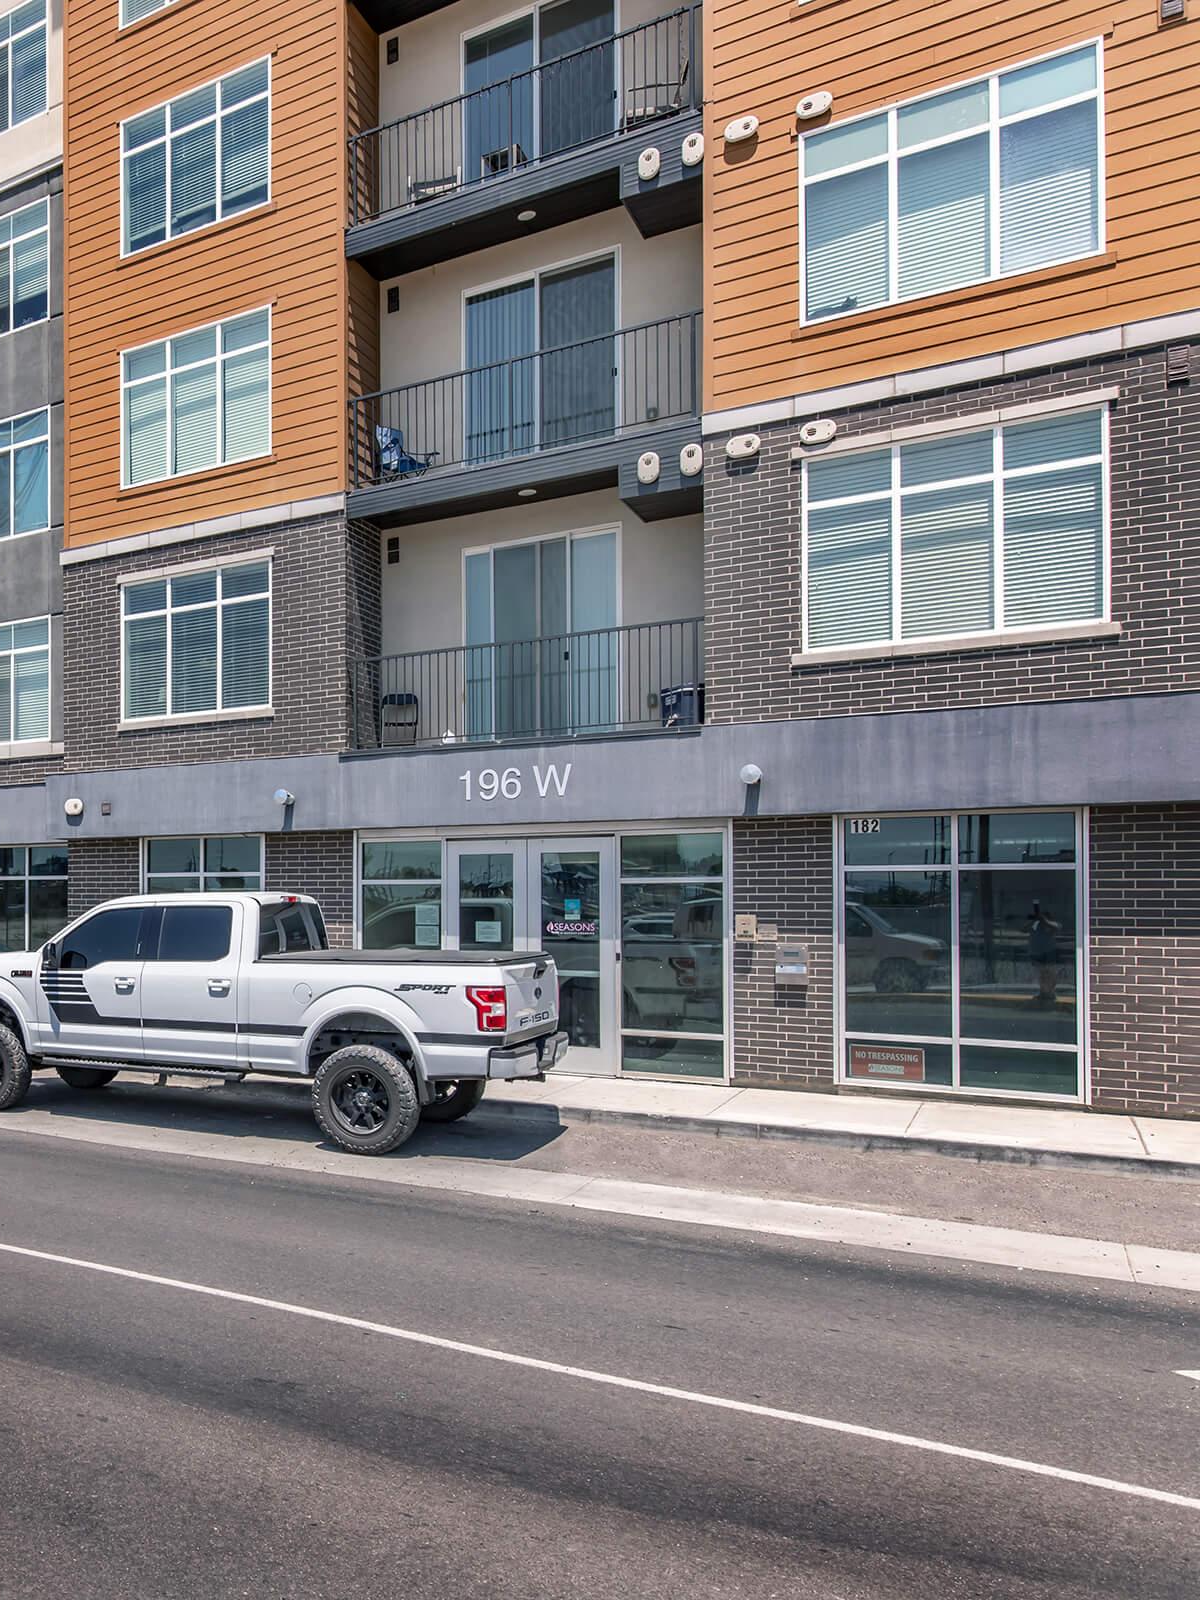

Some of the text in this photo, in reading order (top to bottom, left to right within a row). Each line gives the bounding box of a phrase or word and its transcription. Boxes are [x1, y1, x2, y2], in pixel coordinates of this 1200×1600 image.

[459, 763, 572, 801] 196 W
[851, 819, 879, 833] 182
[554, 922, 596, 932] SEASONS
[520, 1010, 550, 1027] F-150
[855, 1050, 919, 1063] NO TRESPASSING
